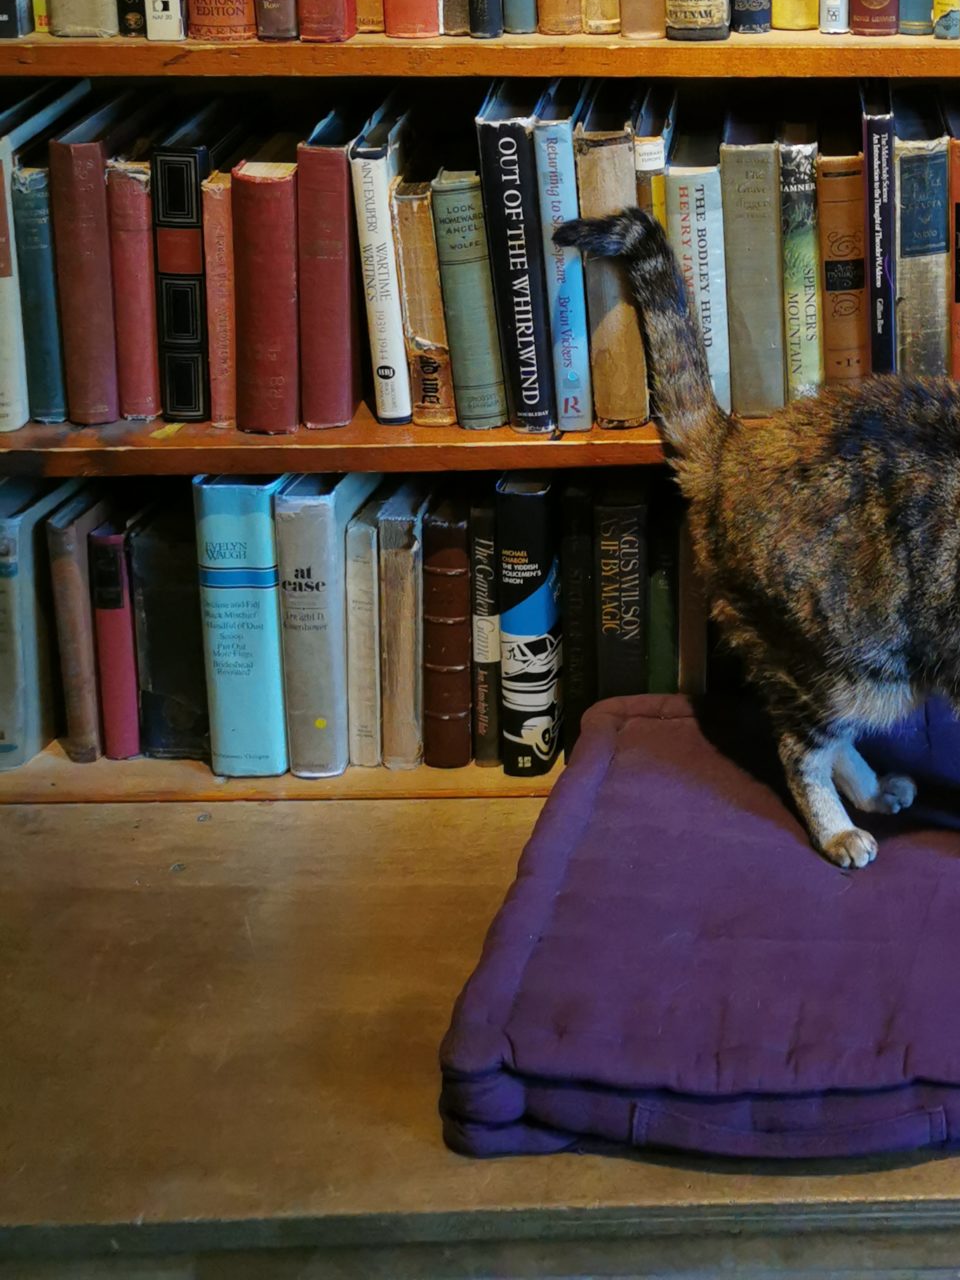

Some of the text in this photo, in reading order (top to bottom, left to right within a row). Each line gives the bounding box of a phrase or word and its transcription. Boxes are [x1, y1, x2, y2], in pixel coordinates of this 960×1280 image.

[195, 6, 245, 17] EDITION
[446, 204, 476, 214] LOOK
[446, 223, 481, 234] ANGEL
[361, 242, 377, 303] WRITINGS
[375, 241, 392, 301] WARTIME
[498, 136, 540, 406] OUT OF THE WHIRLWIND
[694, 184, 714, 348] THE BODLEY HEAD
[802, 267, 818, 342] SPENCER'S
[558, 295, 577, 369] Brian Vickers
[786, 292, 804, 375] MOUNTAIN
[205, 541, 248, 551] EVELYN
[205, 551, 248, 560] WAUGH
[501, 549, 528, 558] MICHAEL
[501, 556, 529, 564] CHABON
[293, 567, 312, 580] at
[281, 580, 327, 594] ease
[601, 539, 621, 635] IF BY MAGIC
